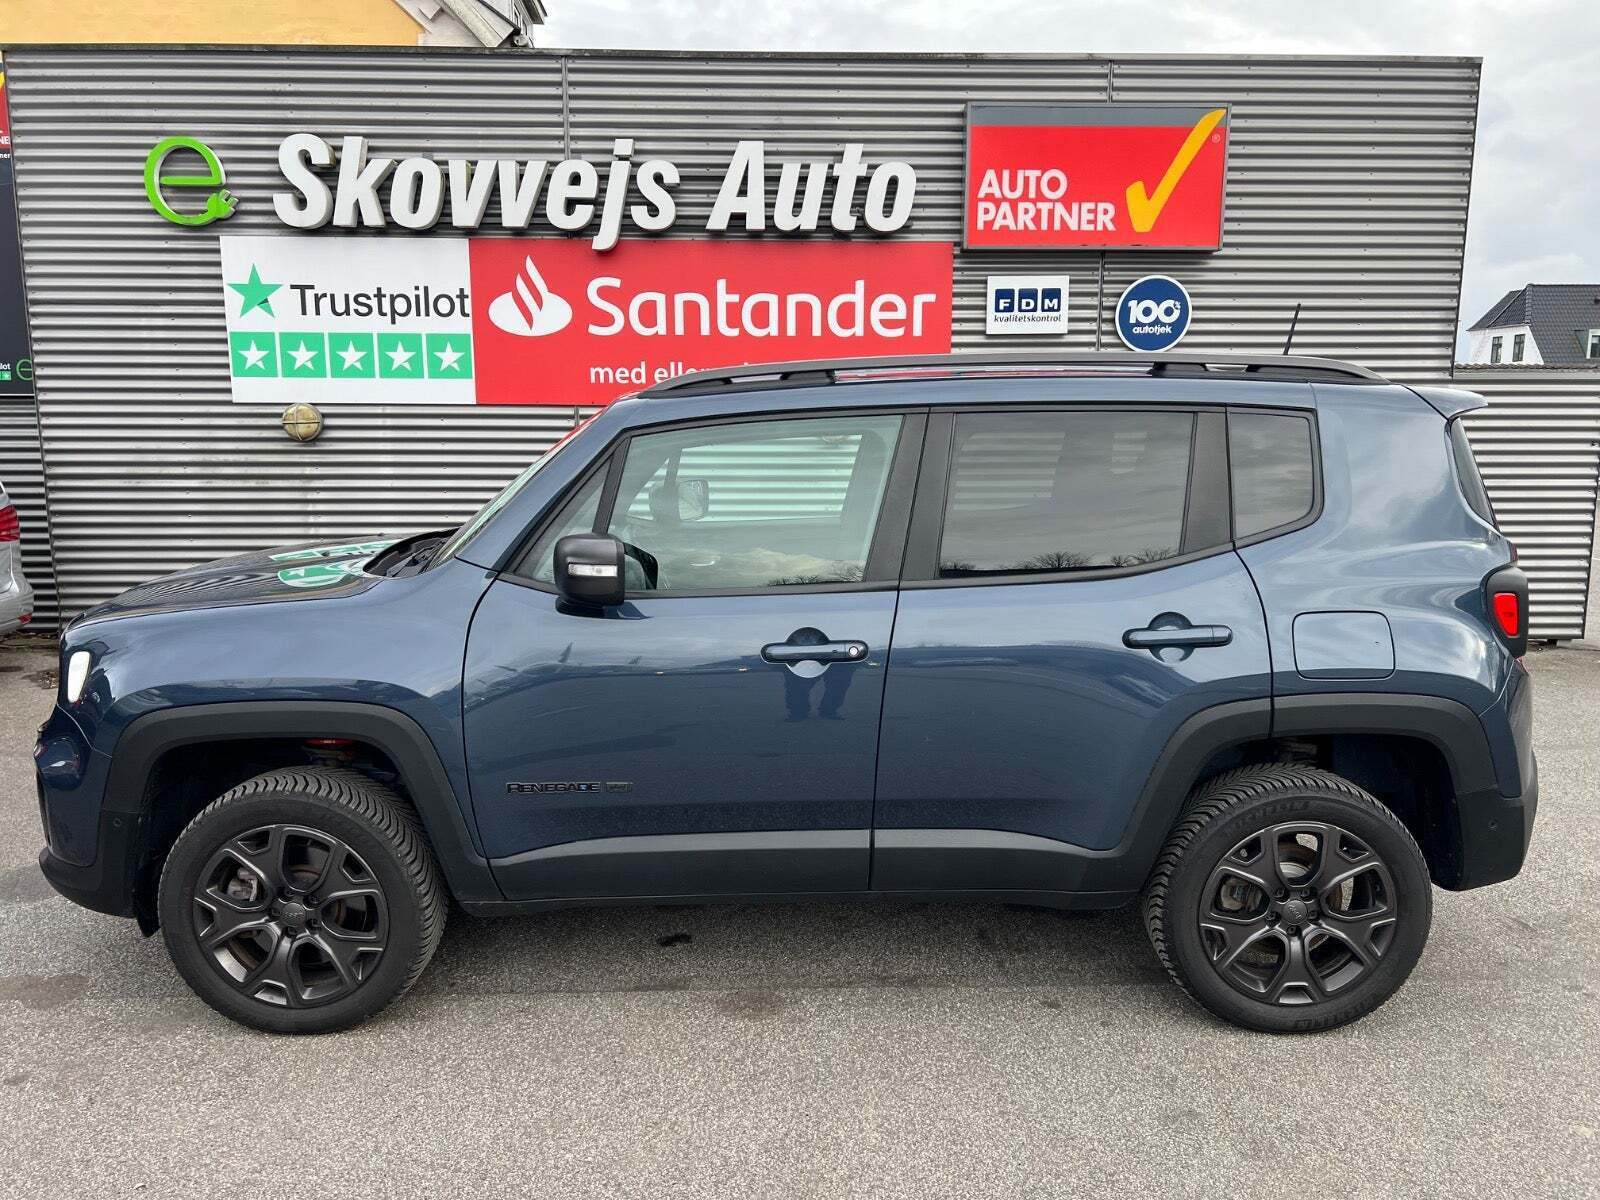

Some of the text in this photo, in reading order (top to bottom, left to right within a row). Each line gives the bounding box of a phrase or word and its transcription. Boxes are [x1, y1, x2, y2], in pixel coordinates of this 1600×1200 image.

[272, 133, 681, 251] Skovvejs
[705, 140, 917, 233] Auto
[976, 168, 1068, 200] AUTO
[976, 202, 1116, 232] PARTNER
[289, 283, 471, 325] Trustpilot
[586, 276, 936, 338] Santander
[994, 314, 1062, 323] kvalitetskontrol
[1132, 324, 1173, 335] autotjek
[590, 361, 646, 384] med
[507, 782, 600, 793] RENEGADE
